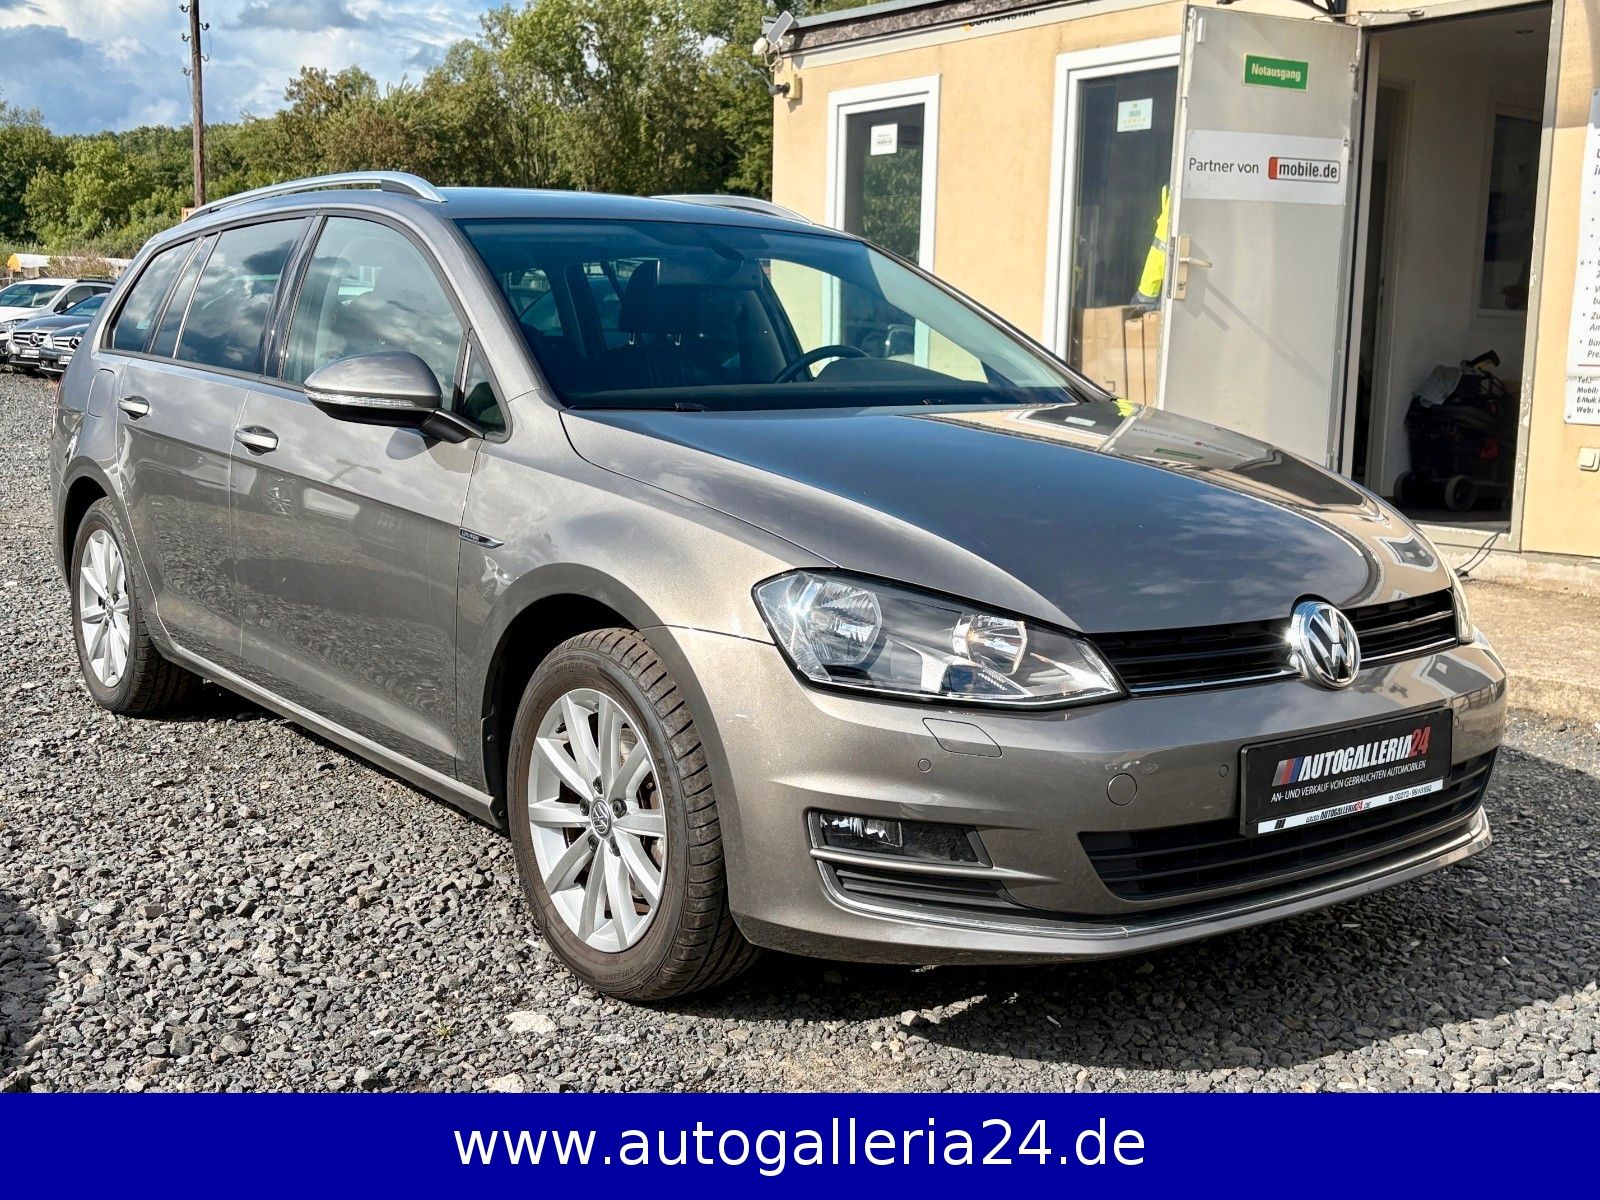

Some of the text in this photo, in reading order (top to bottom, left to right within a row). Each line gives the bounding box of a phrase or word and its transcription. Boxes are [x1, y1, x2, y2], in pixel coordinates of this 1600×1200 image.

[1251, 62, 1302, 82] Notausgang
[1188, 157, 1339, 179] Partner von mobile.de
[1297, 726, 1431, 782] AUTOGALLERIA24
[1270, 759, 1427, 803] AN- UND VERKAUF VON GEBRAUCHTEN AUTOMOBILEN
